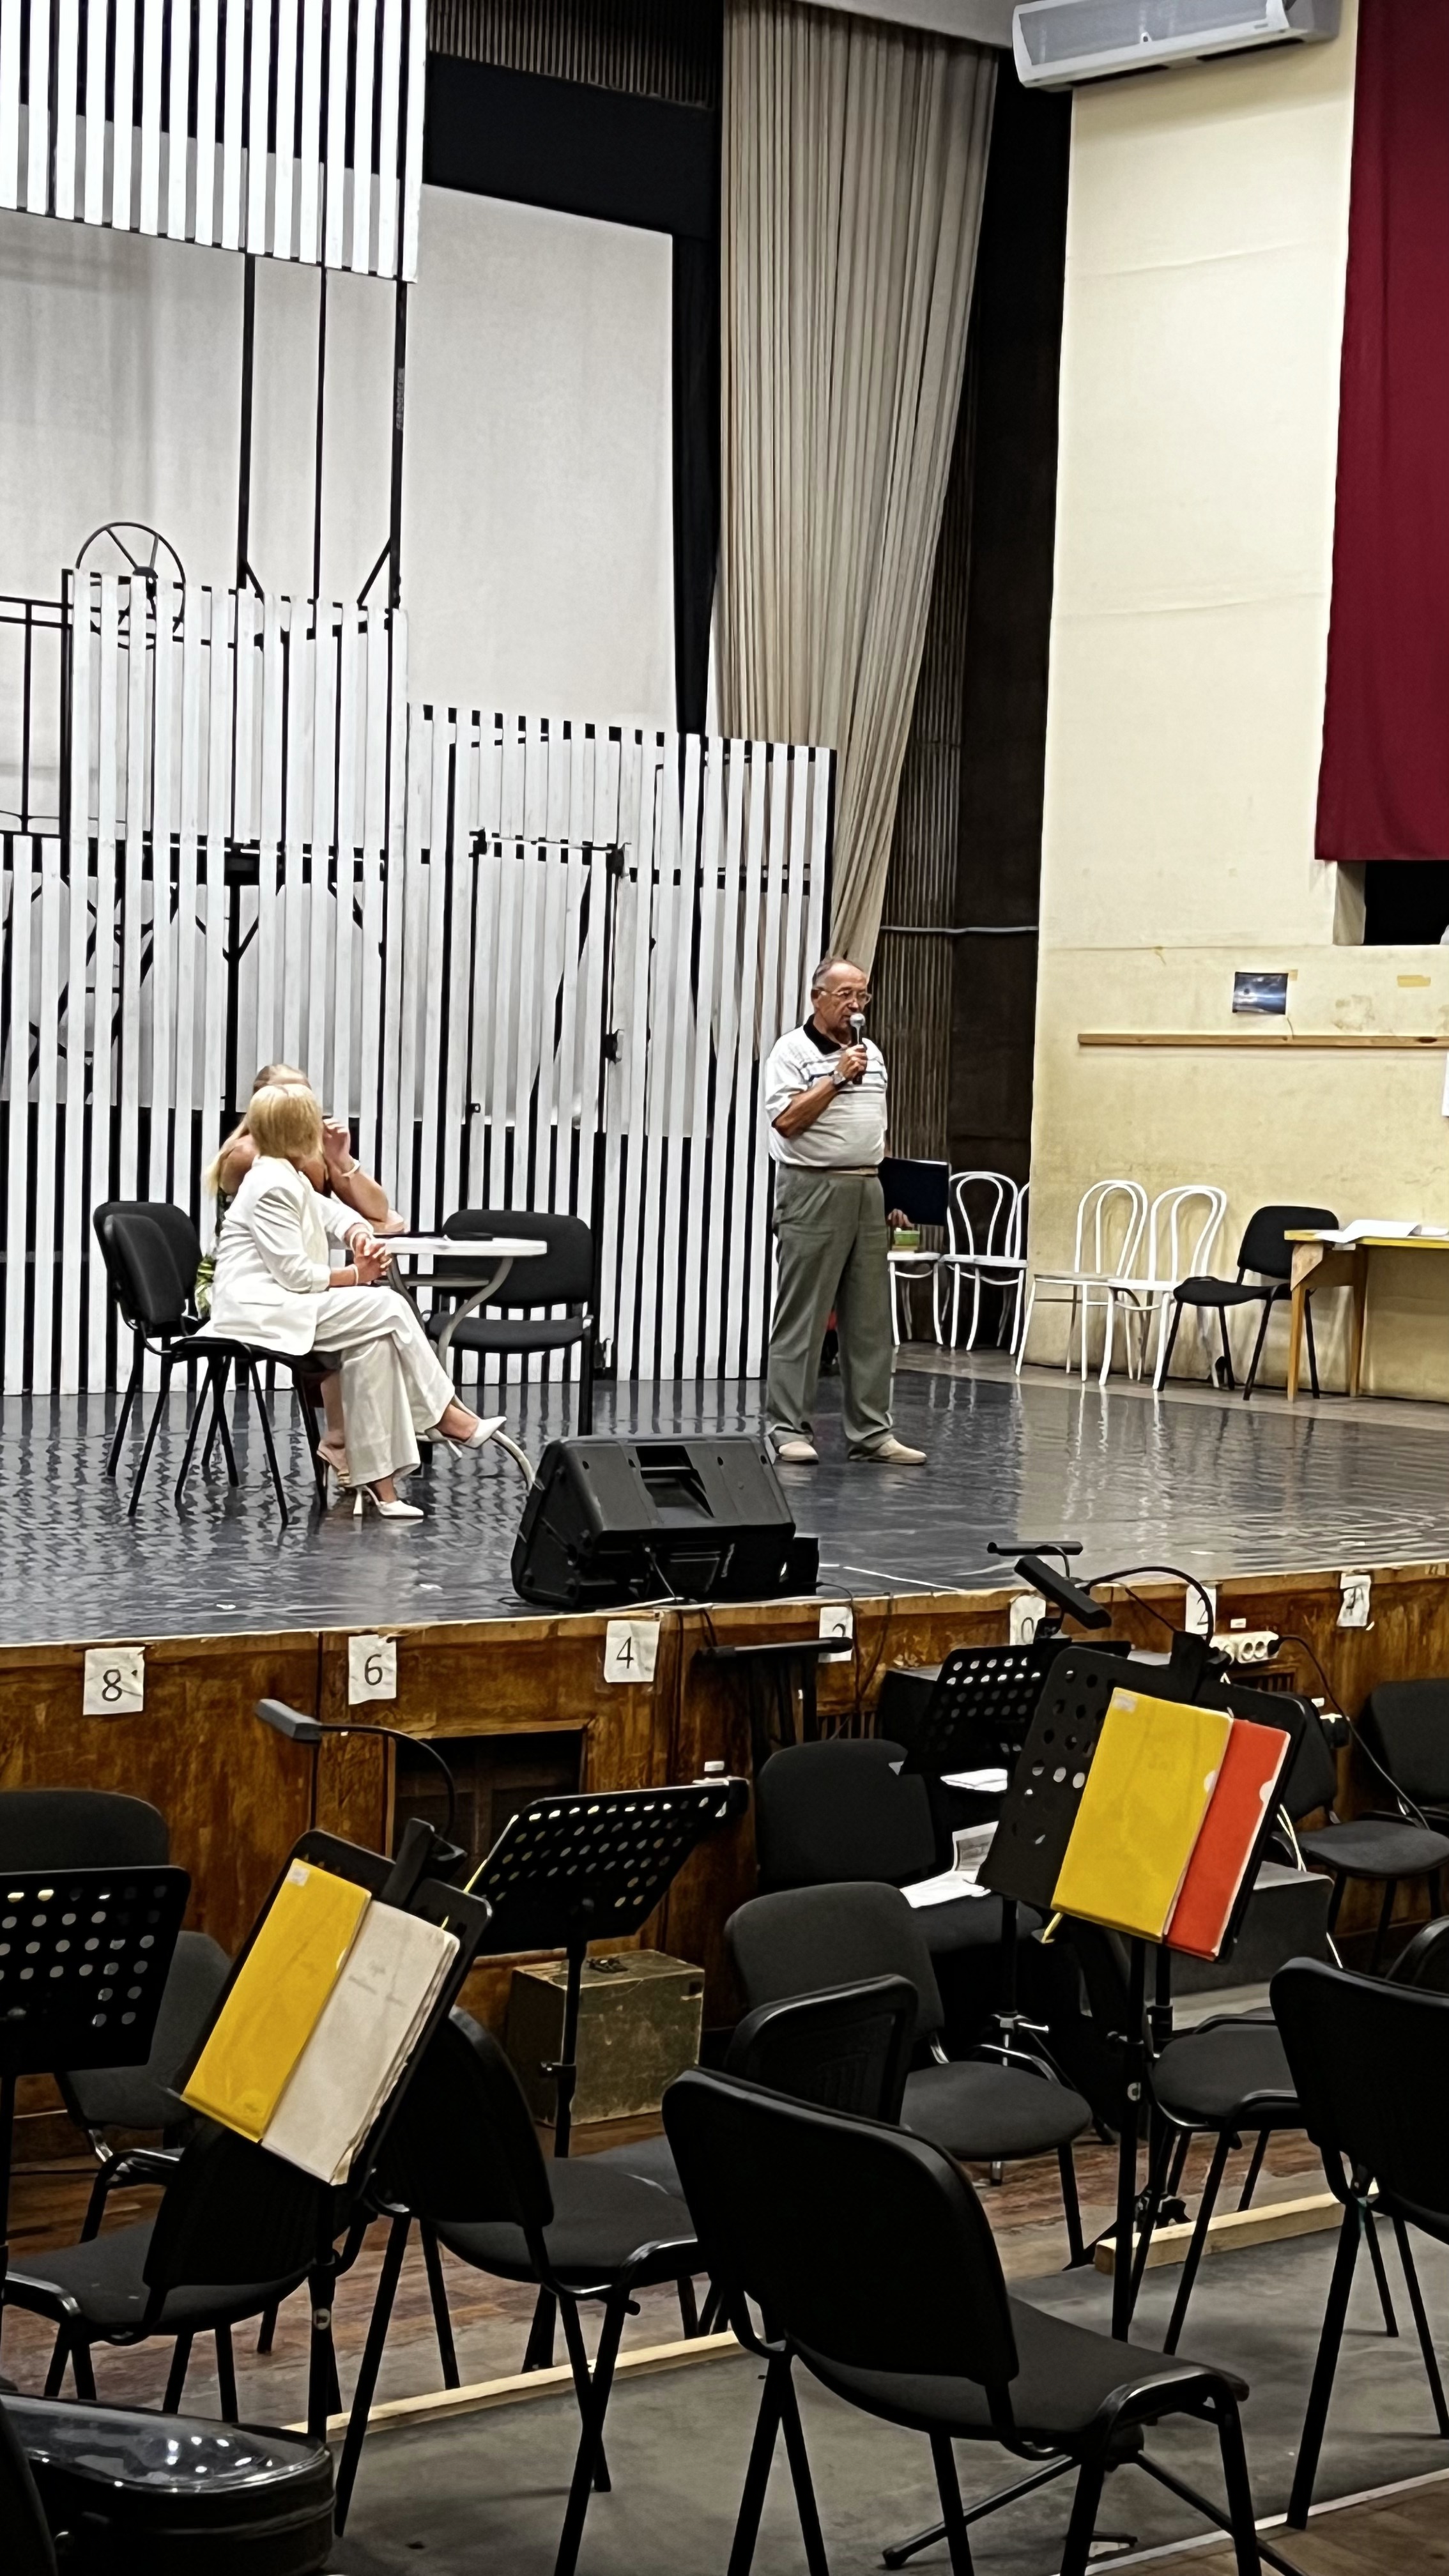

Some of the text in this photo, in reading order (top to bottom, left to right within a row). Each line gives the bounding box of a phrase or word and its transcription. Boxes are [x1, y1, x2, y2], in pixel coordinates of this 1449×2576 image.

[364, 1653, 383, 1685] 6
[616, 1636, 634, 1669] 4
[102, 1669, 123, 1702] 8
